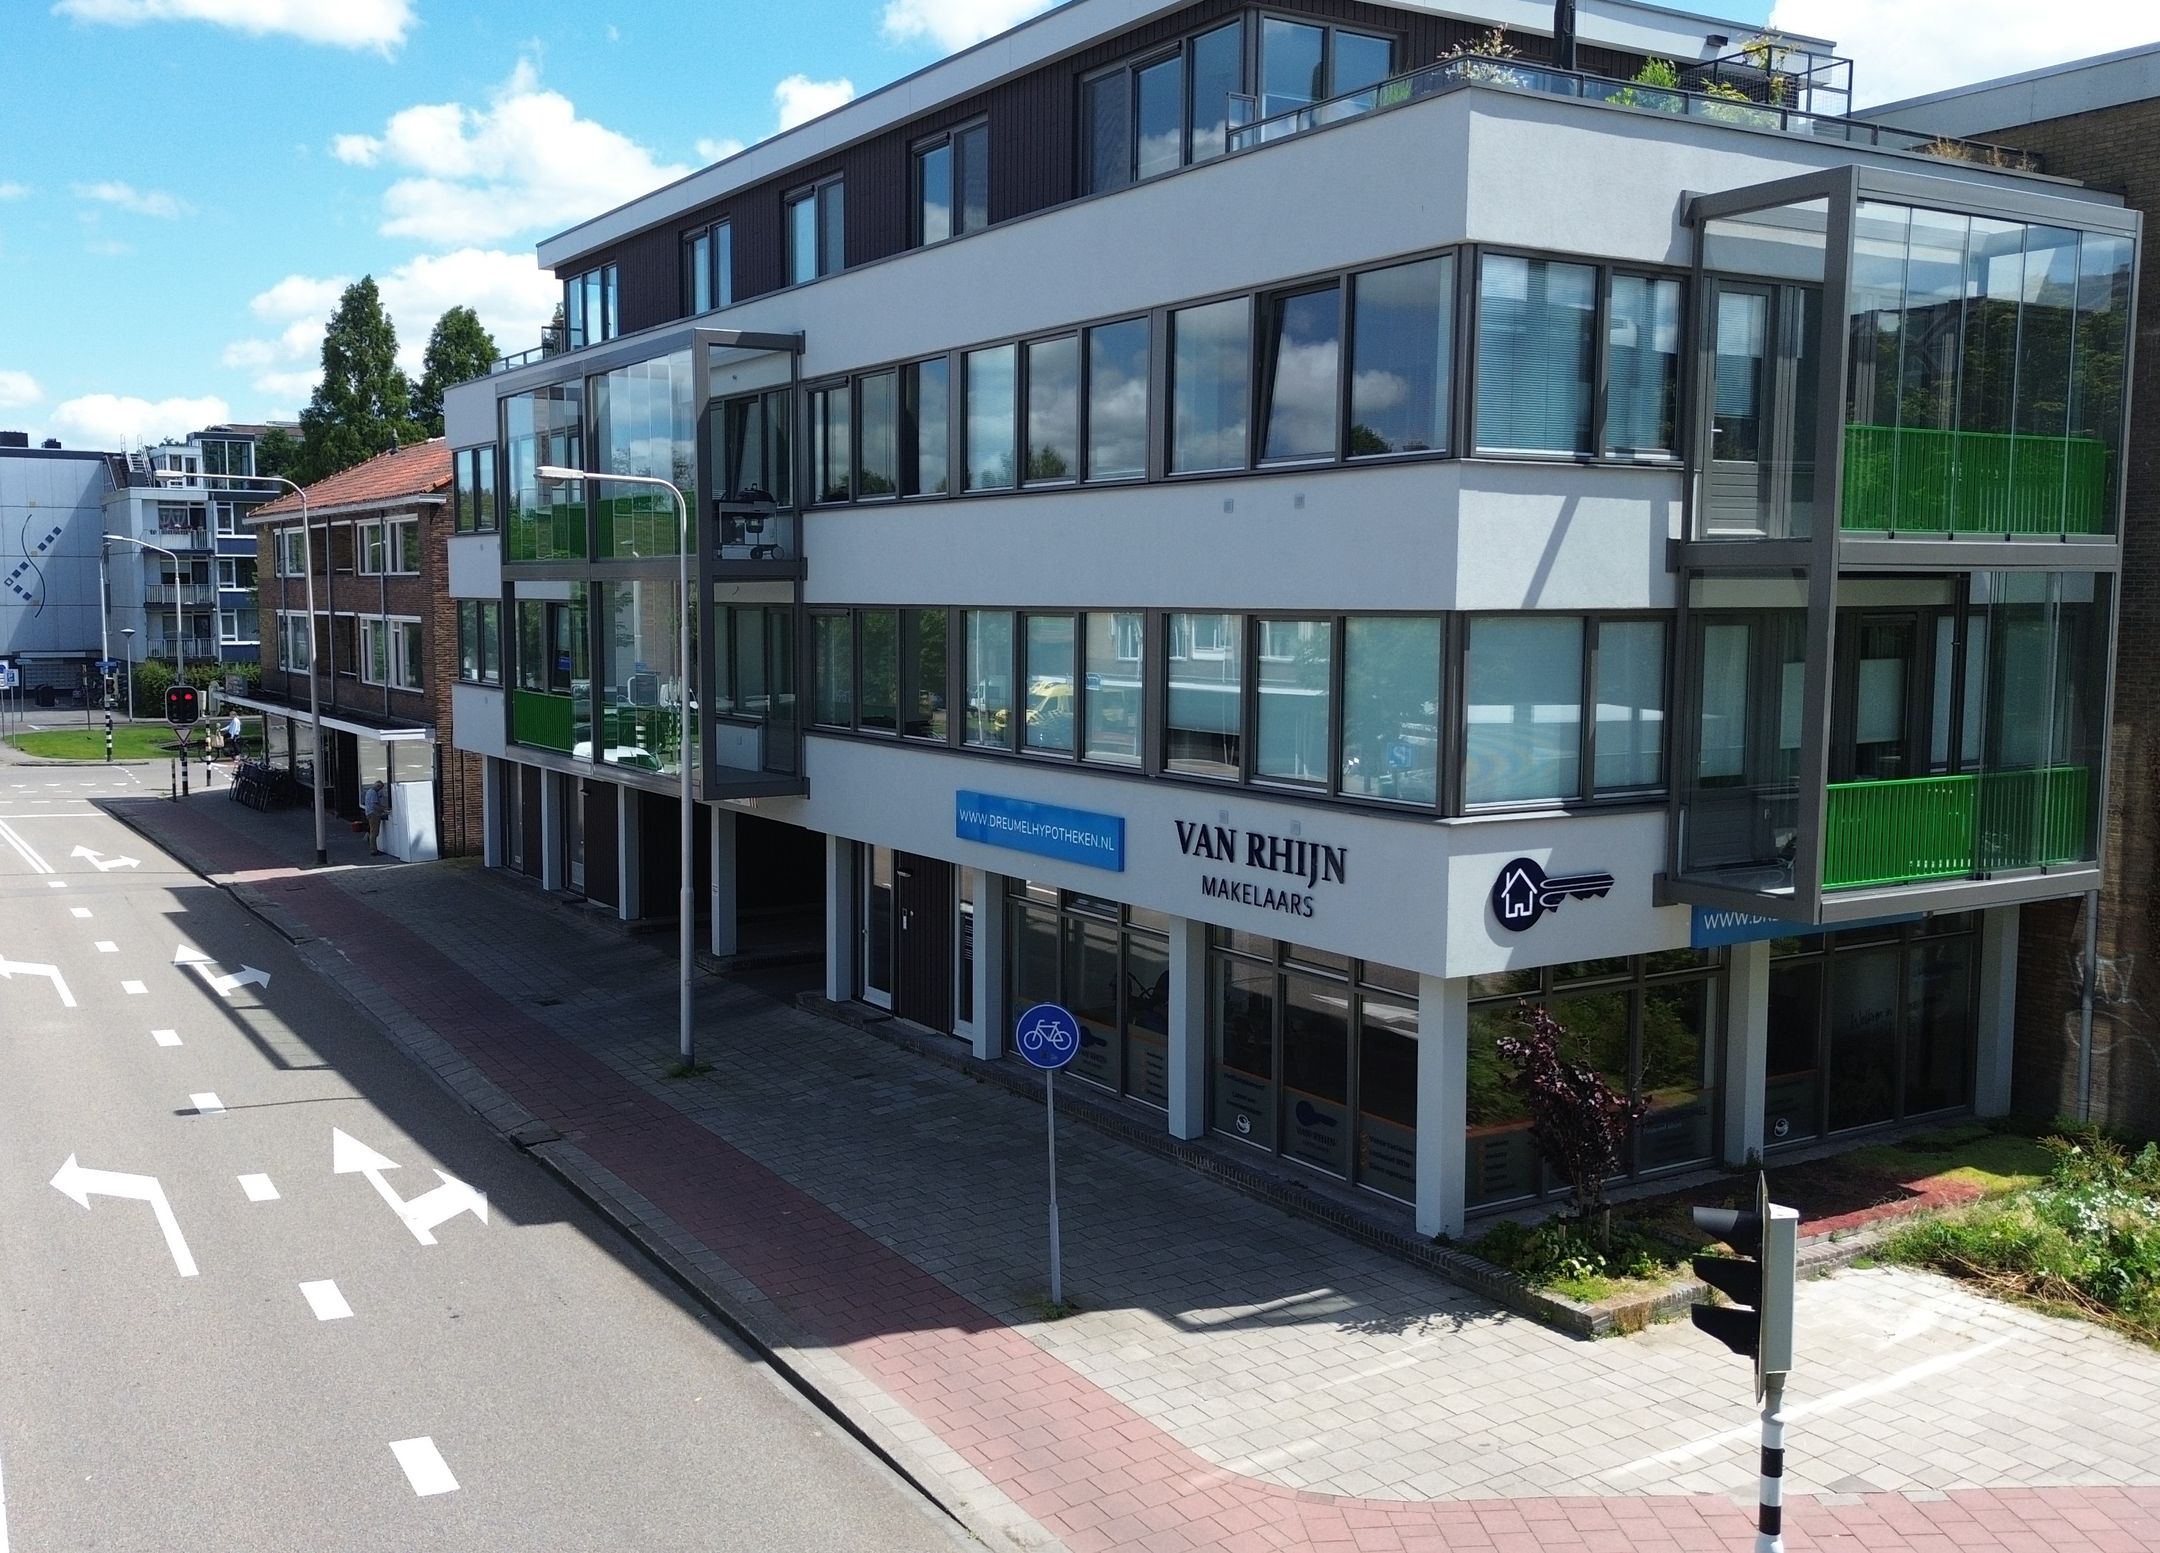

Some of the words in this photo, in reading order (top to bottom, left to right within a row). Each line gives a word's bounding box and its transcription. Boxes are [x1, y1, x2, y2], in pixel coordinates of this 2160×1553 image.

[958, 808, 1115, 852] WWW.DREUMELHYPOTHEKEN.NL
[1174, 819, 1237, 864] VAN
[1245, 831, 1348, 889] RHIJN
[1201, 874, 1315, 919] MAKELAARS
